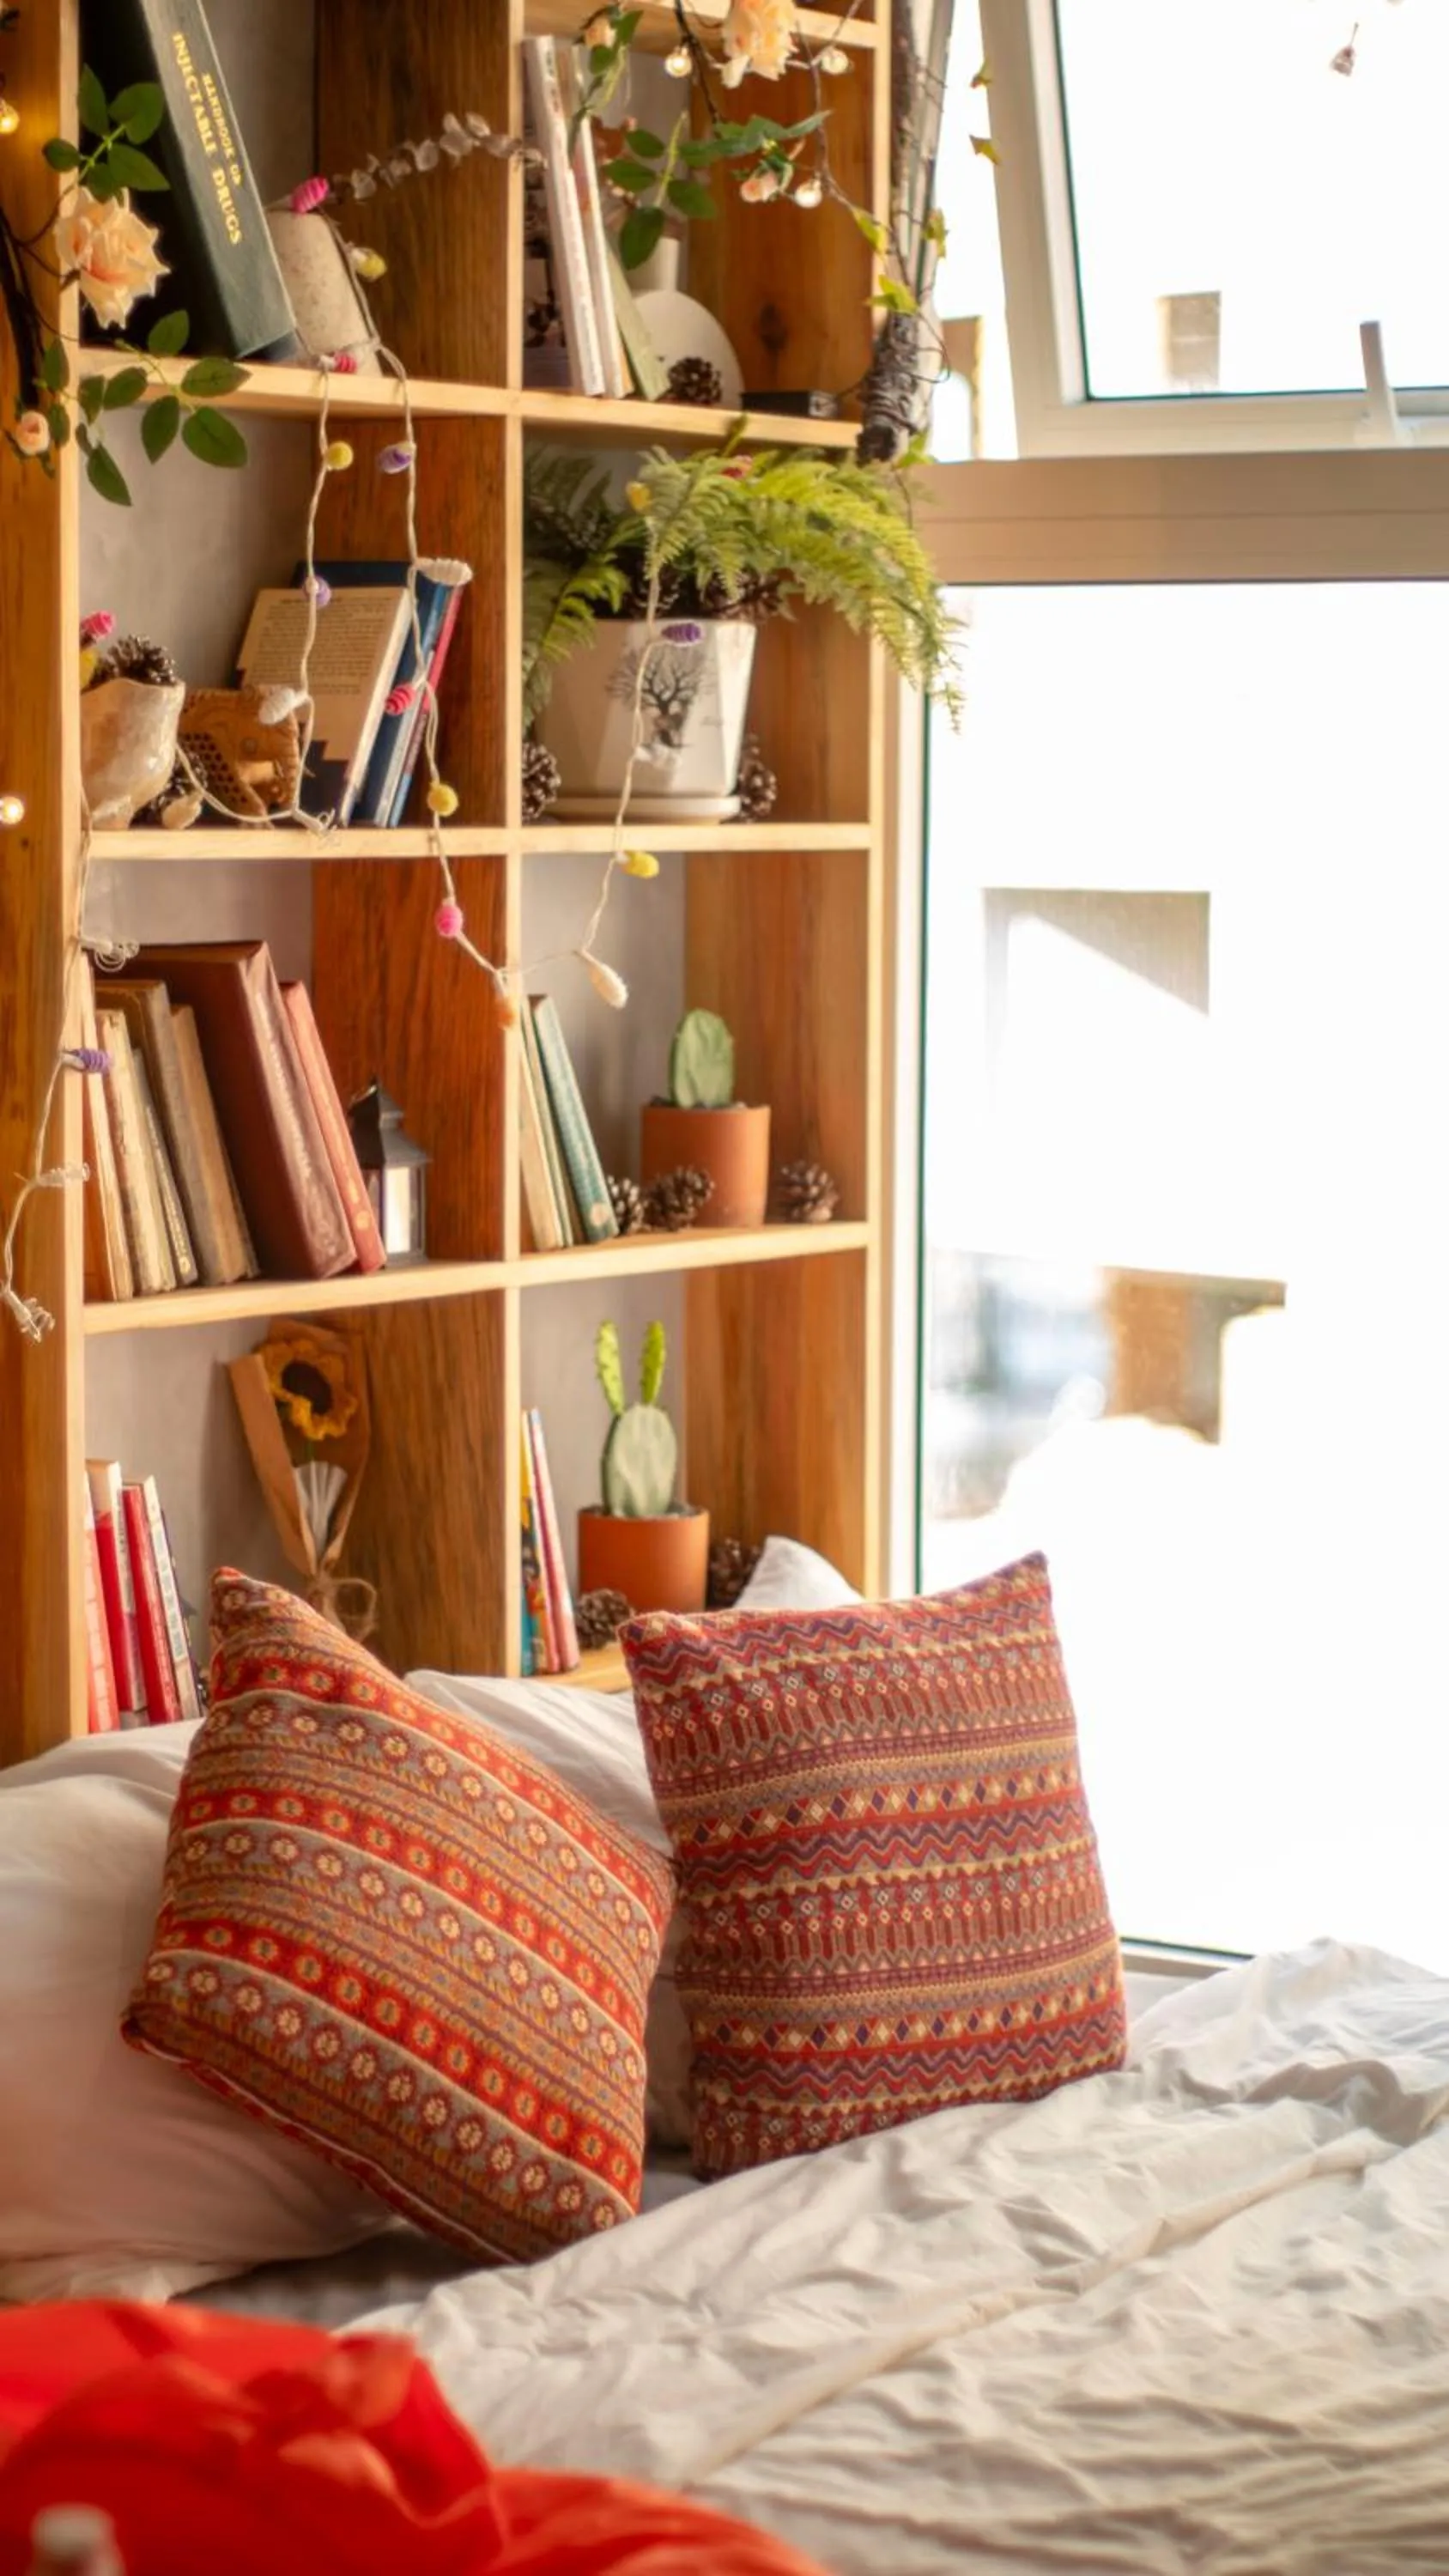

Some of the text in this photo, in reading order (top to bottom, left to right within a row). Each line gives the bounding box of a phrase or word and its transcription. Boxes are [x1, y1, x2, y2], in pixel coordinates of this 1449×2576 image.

[173, 32, 241, 246] INJECTABLE DRUGS
[203, 73, 241, 185] HANDBOOK OF
